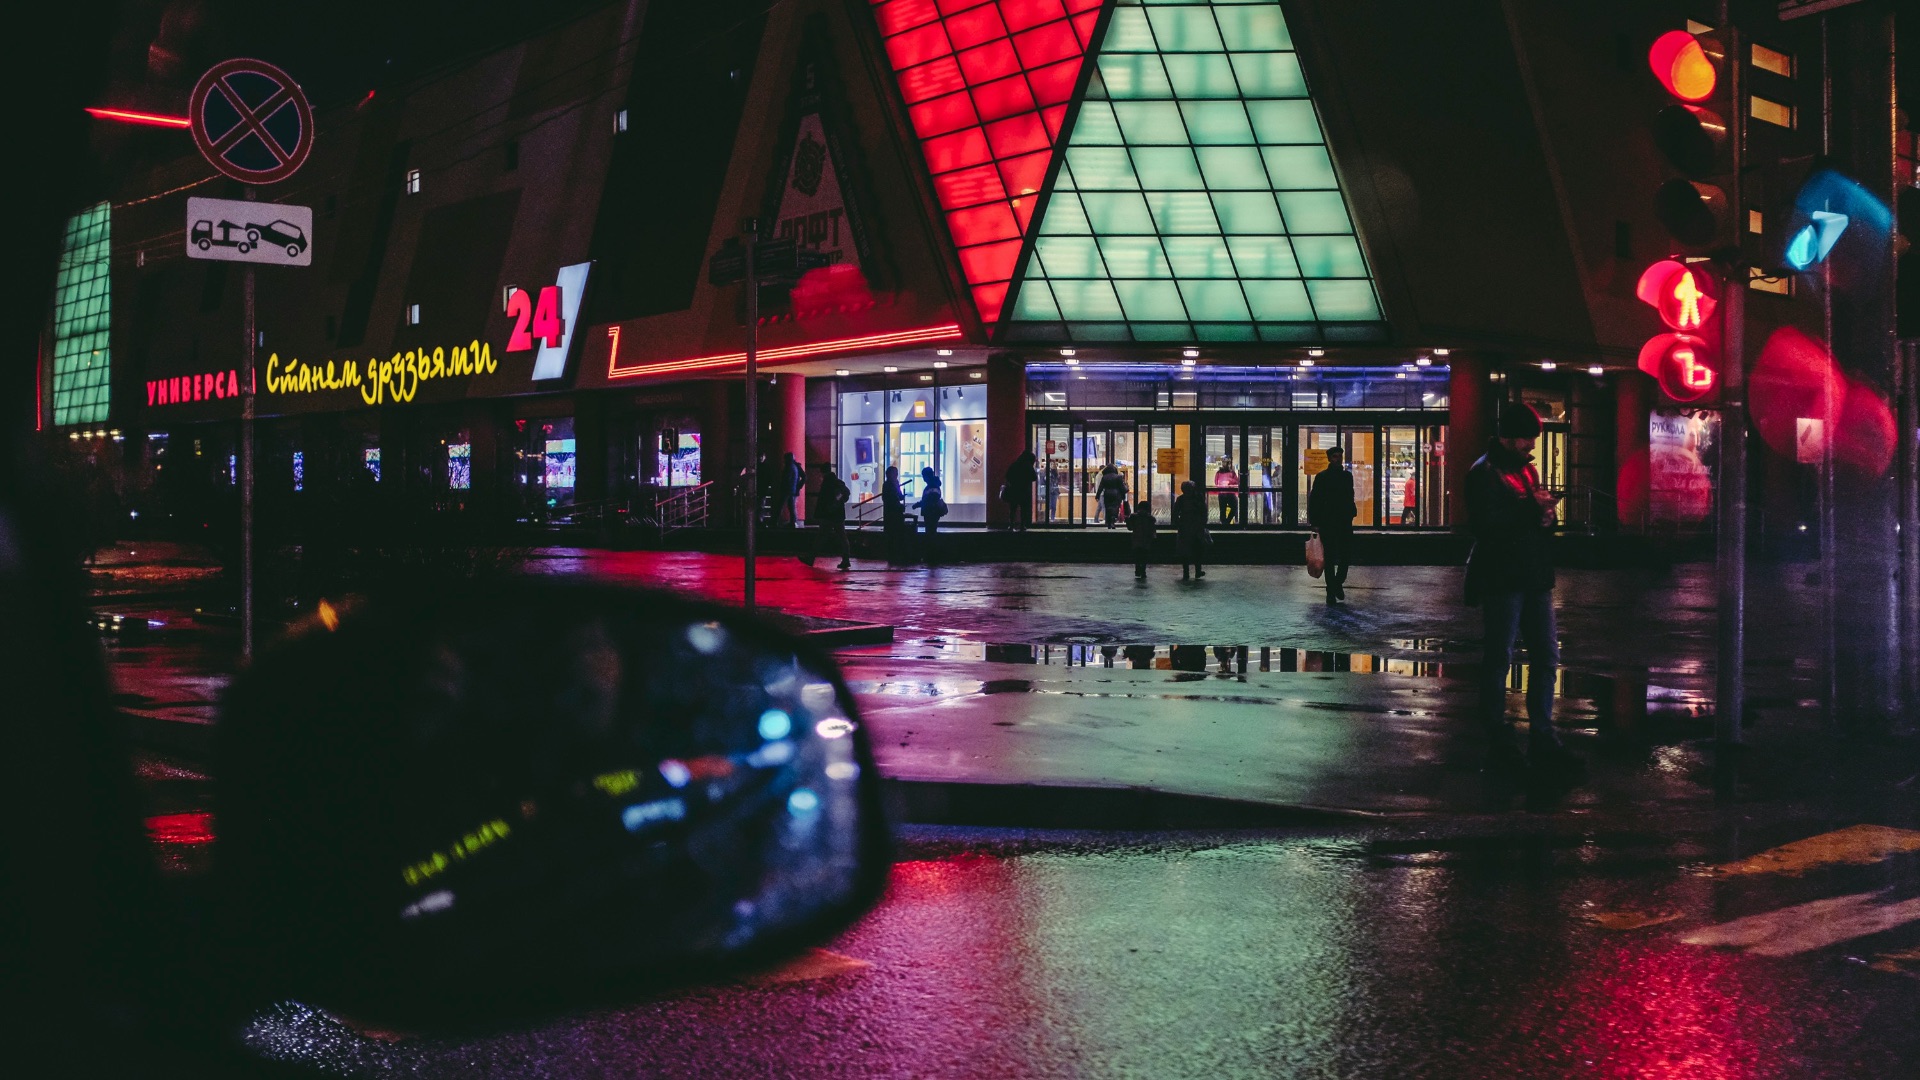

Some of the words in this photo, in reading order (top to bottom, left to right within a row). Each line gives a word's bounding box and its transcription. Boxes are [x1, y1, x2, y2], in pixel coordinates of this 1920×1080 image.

[506, 285, 566, 353] 24
[146, 367, 257, 407] УНИВЕРСА
[266, 352, 362, 394] Станем
[361, 339, 498, 405] друзьями
